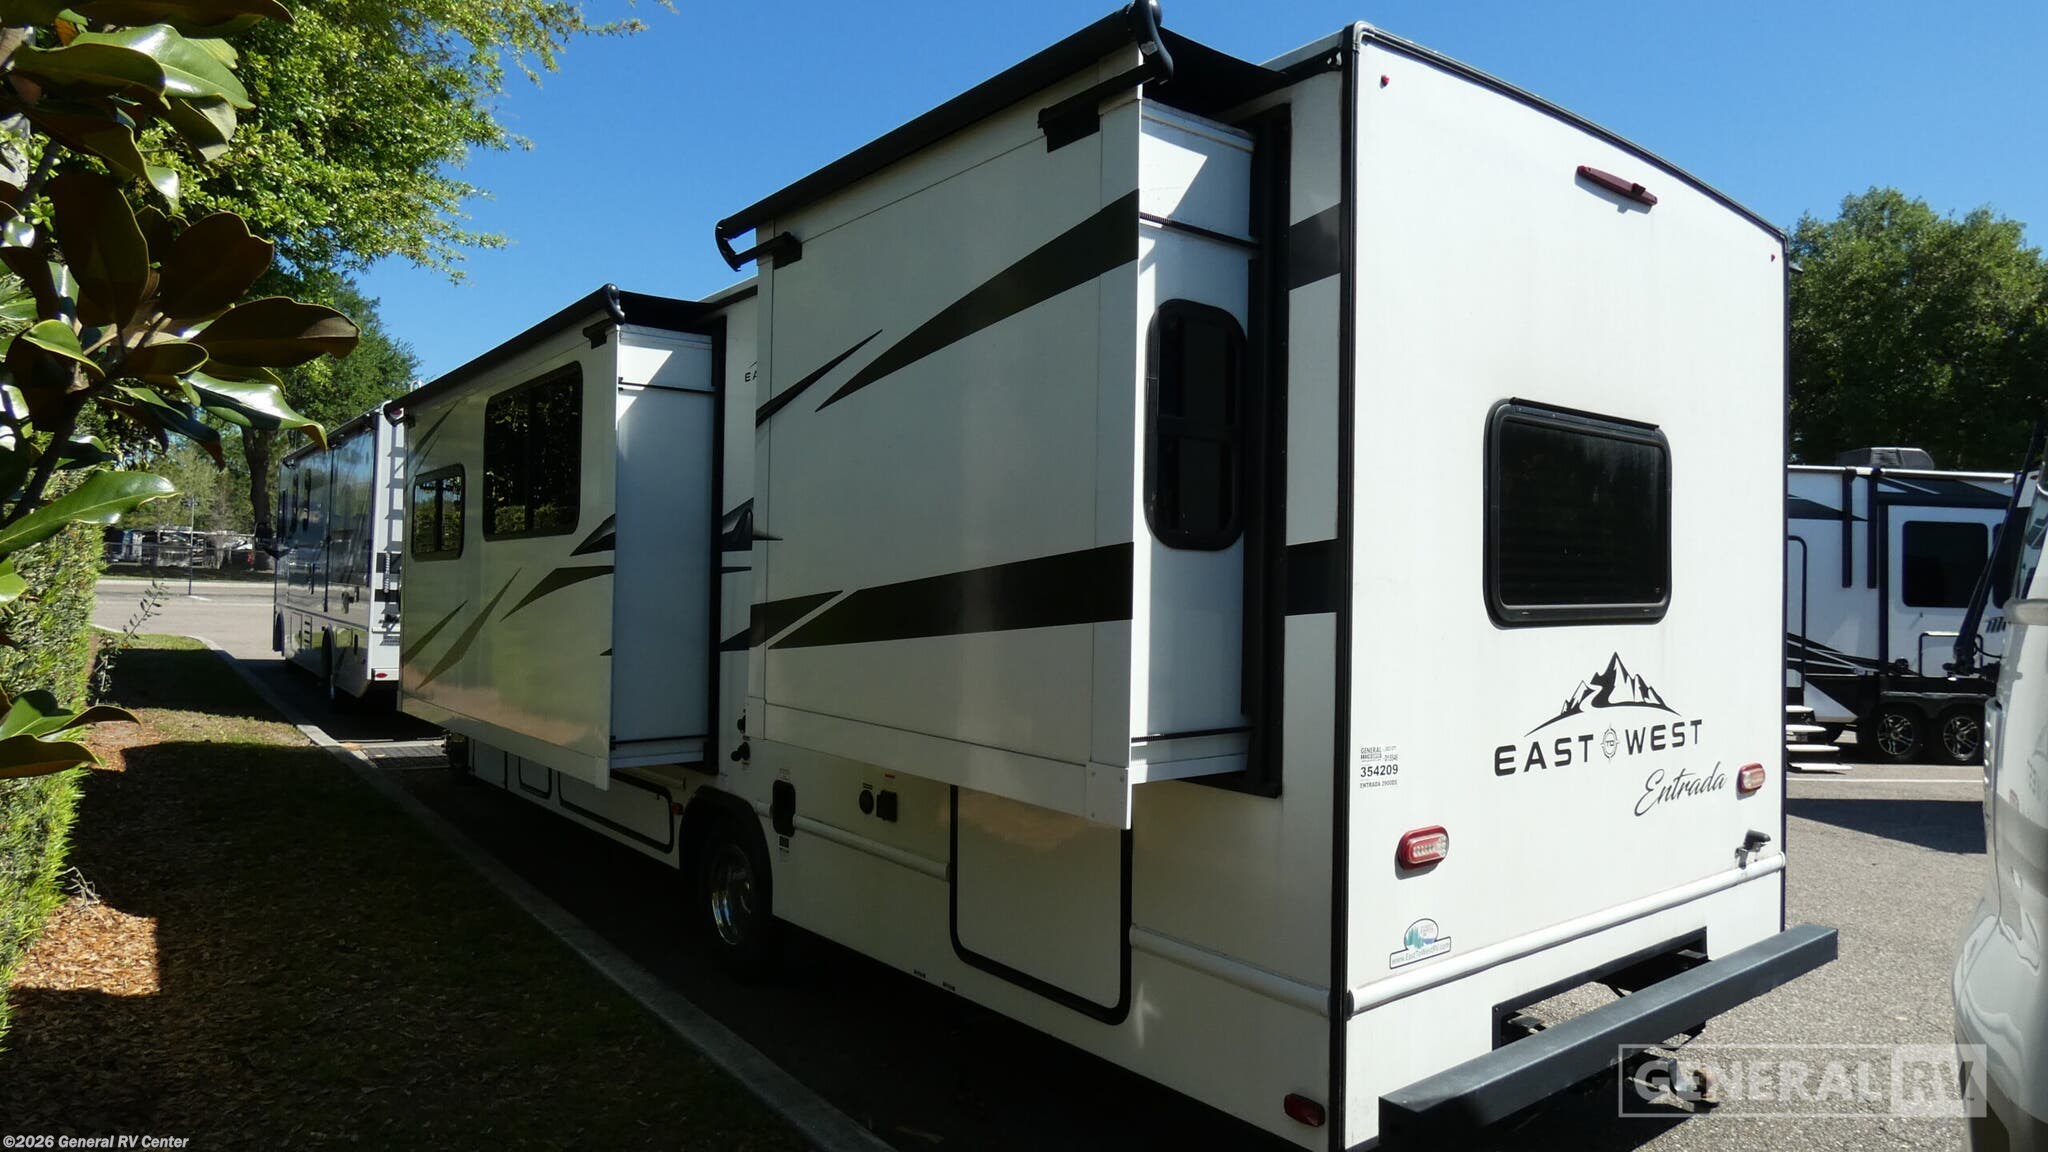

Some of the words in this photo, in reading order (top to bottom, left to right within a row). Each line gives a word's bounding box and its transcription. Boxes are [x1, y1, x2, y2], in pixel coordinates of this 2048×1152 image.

[1360, 746, 1381, 754] GENERAL
[1494, 733, 1594, 777] EAST
[1625, 719, 1703, 756] WEST
[1360, 764, 1398, 777] 354209
[1360, 781, 1381, 789] ENTRADA
[1634, 761, 1728, 817] Entrada
